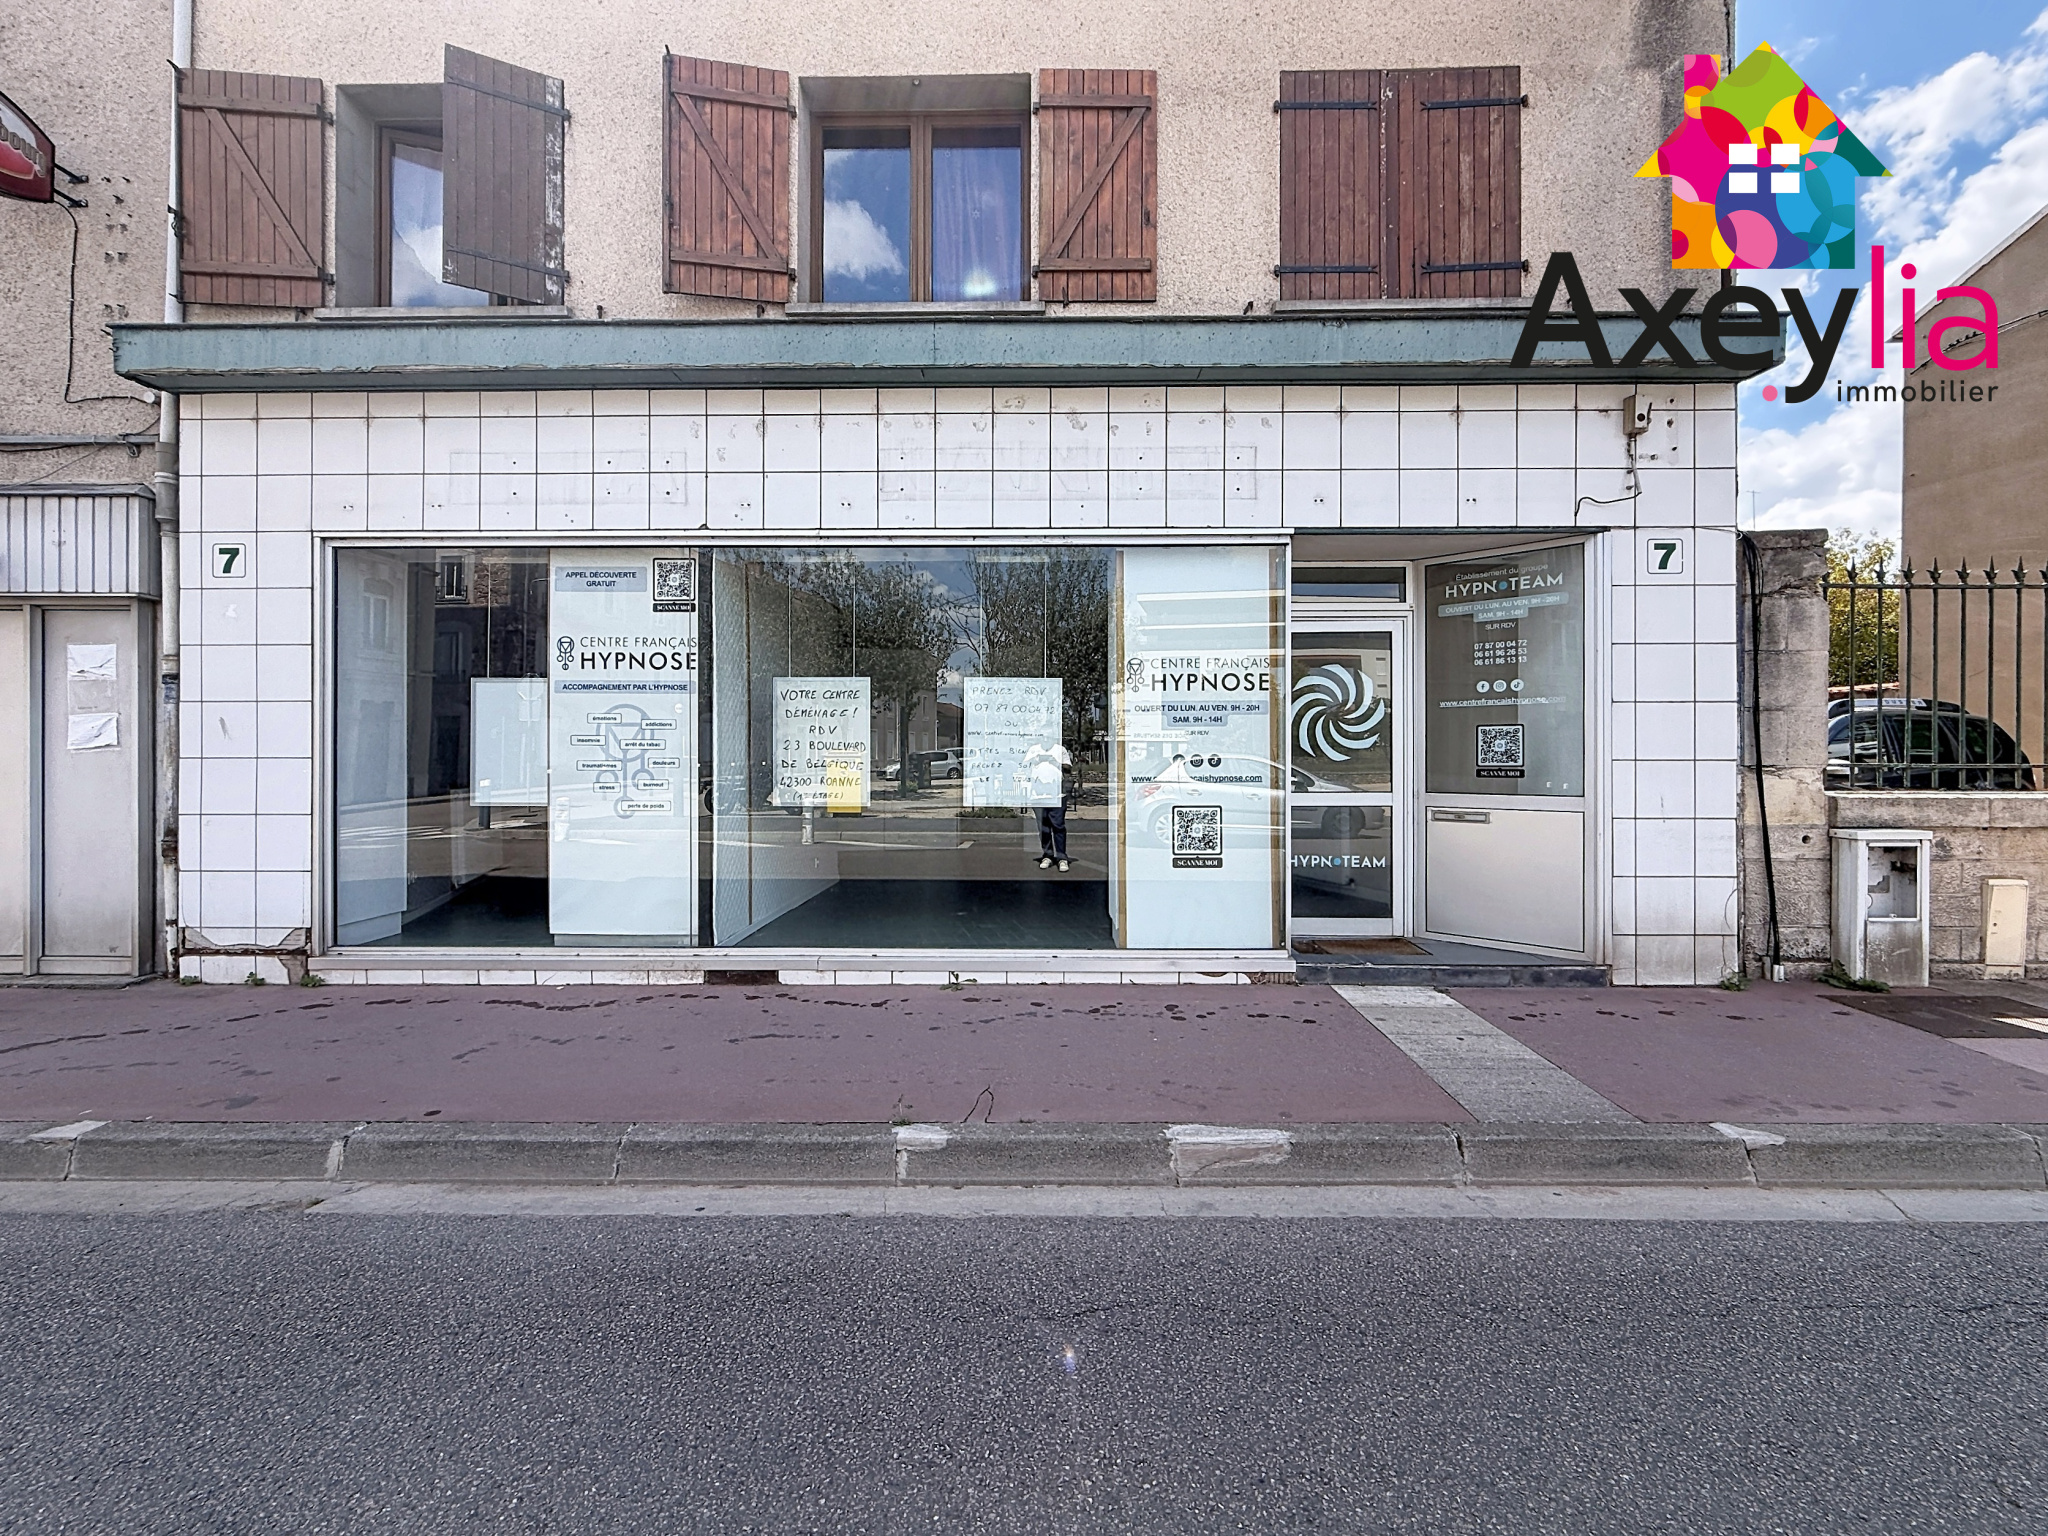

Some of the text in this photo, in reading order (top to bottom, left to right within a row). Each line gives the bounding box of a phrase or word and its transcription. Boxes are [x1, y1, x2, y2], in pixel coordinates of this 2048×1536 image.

[218, 548, 240, 574] 7
[1654, 543, 1676, 570] 7
[589, 570, 637, 578] DÉCOUVERTE
[1456, 563, 1549, 581] Établissement du groupe
[1445, 605, 1472, 614] OUVERT
[1484, 602, 1500, 610] LUN.
[580, 637, 698, 650] CENTRE FRANÇAIS
[581, 652, 697, 670] HYPNOSE
[1151, 657, 1270, 671] CENTRE FRANÇAIS
[1152, 673, 1270, 692] HYPNOSE
[780, 689, 860, 701] VOTRE CENTRE
[972, 686, 1048, 696] PRENEZ RDV
[786, 706, 858, 719] DÉMÉNAGE !
[974, 703, 989, 712] 07
[995, 703, 1008, 713] 87
[1012, 704, 1027, 713] 00
[1028, 704, 1041, 713] 04
[1134, 704, 1166, 712] OUVERT
[809, 725, 838, 735] RDV
[783, 739, 866, 752] 23 BOULEVARD
[782, 759, 864, 771] DE BELGIQUE
[780, 776, 861, 788] 42300 ROANNE
